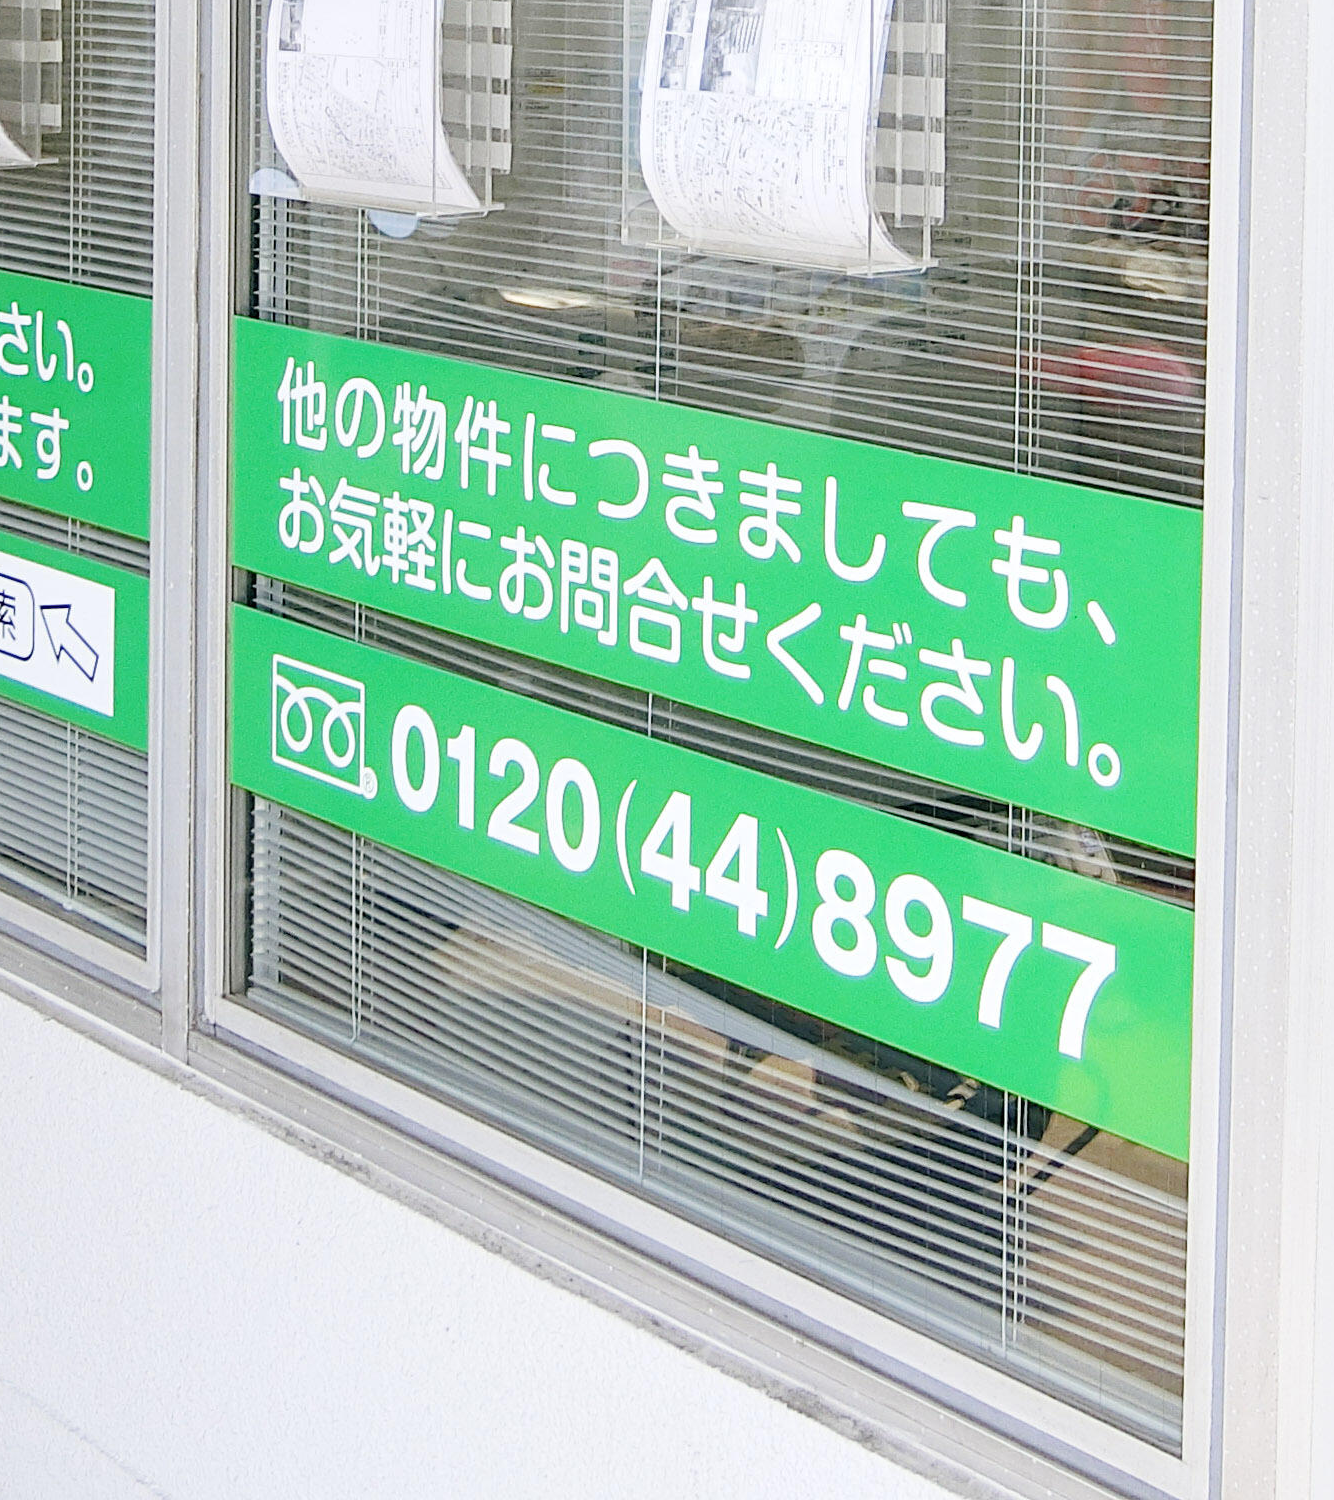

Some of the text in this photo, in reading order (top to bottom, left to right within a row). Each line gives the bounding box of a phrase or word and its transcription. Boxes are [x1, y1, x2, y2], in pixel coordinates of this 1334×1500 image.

[276, 356, 1116, 646] 他の物件につきましても、
[277, 466, 1123, 788] お気軽にお問合せください。
[391, 704, 1117, 1060] 0120(44)8977
